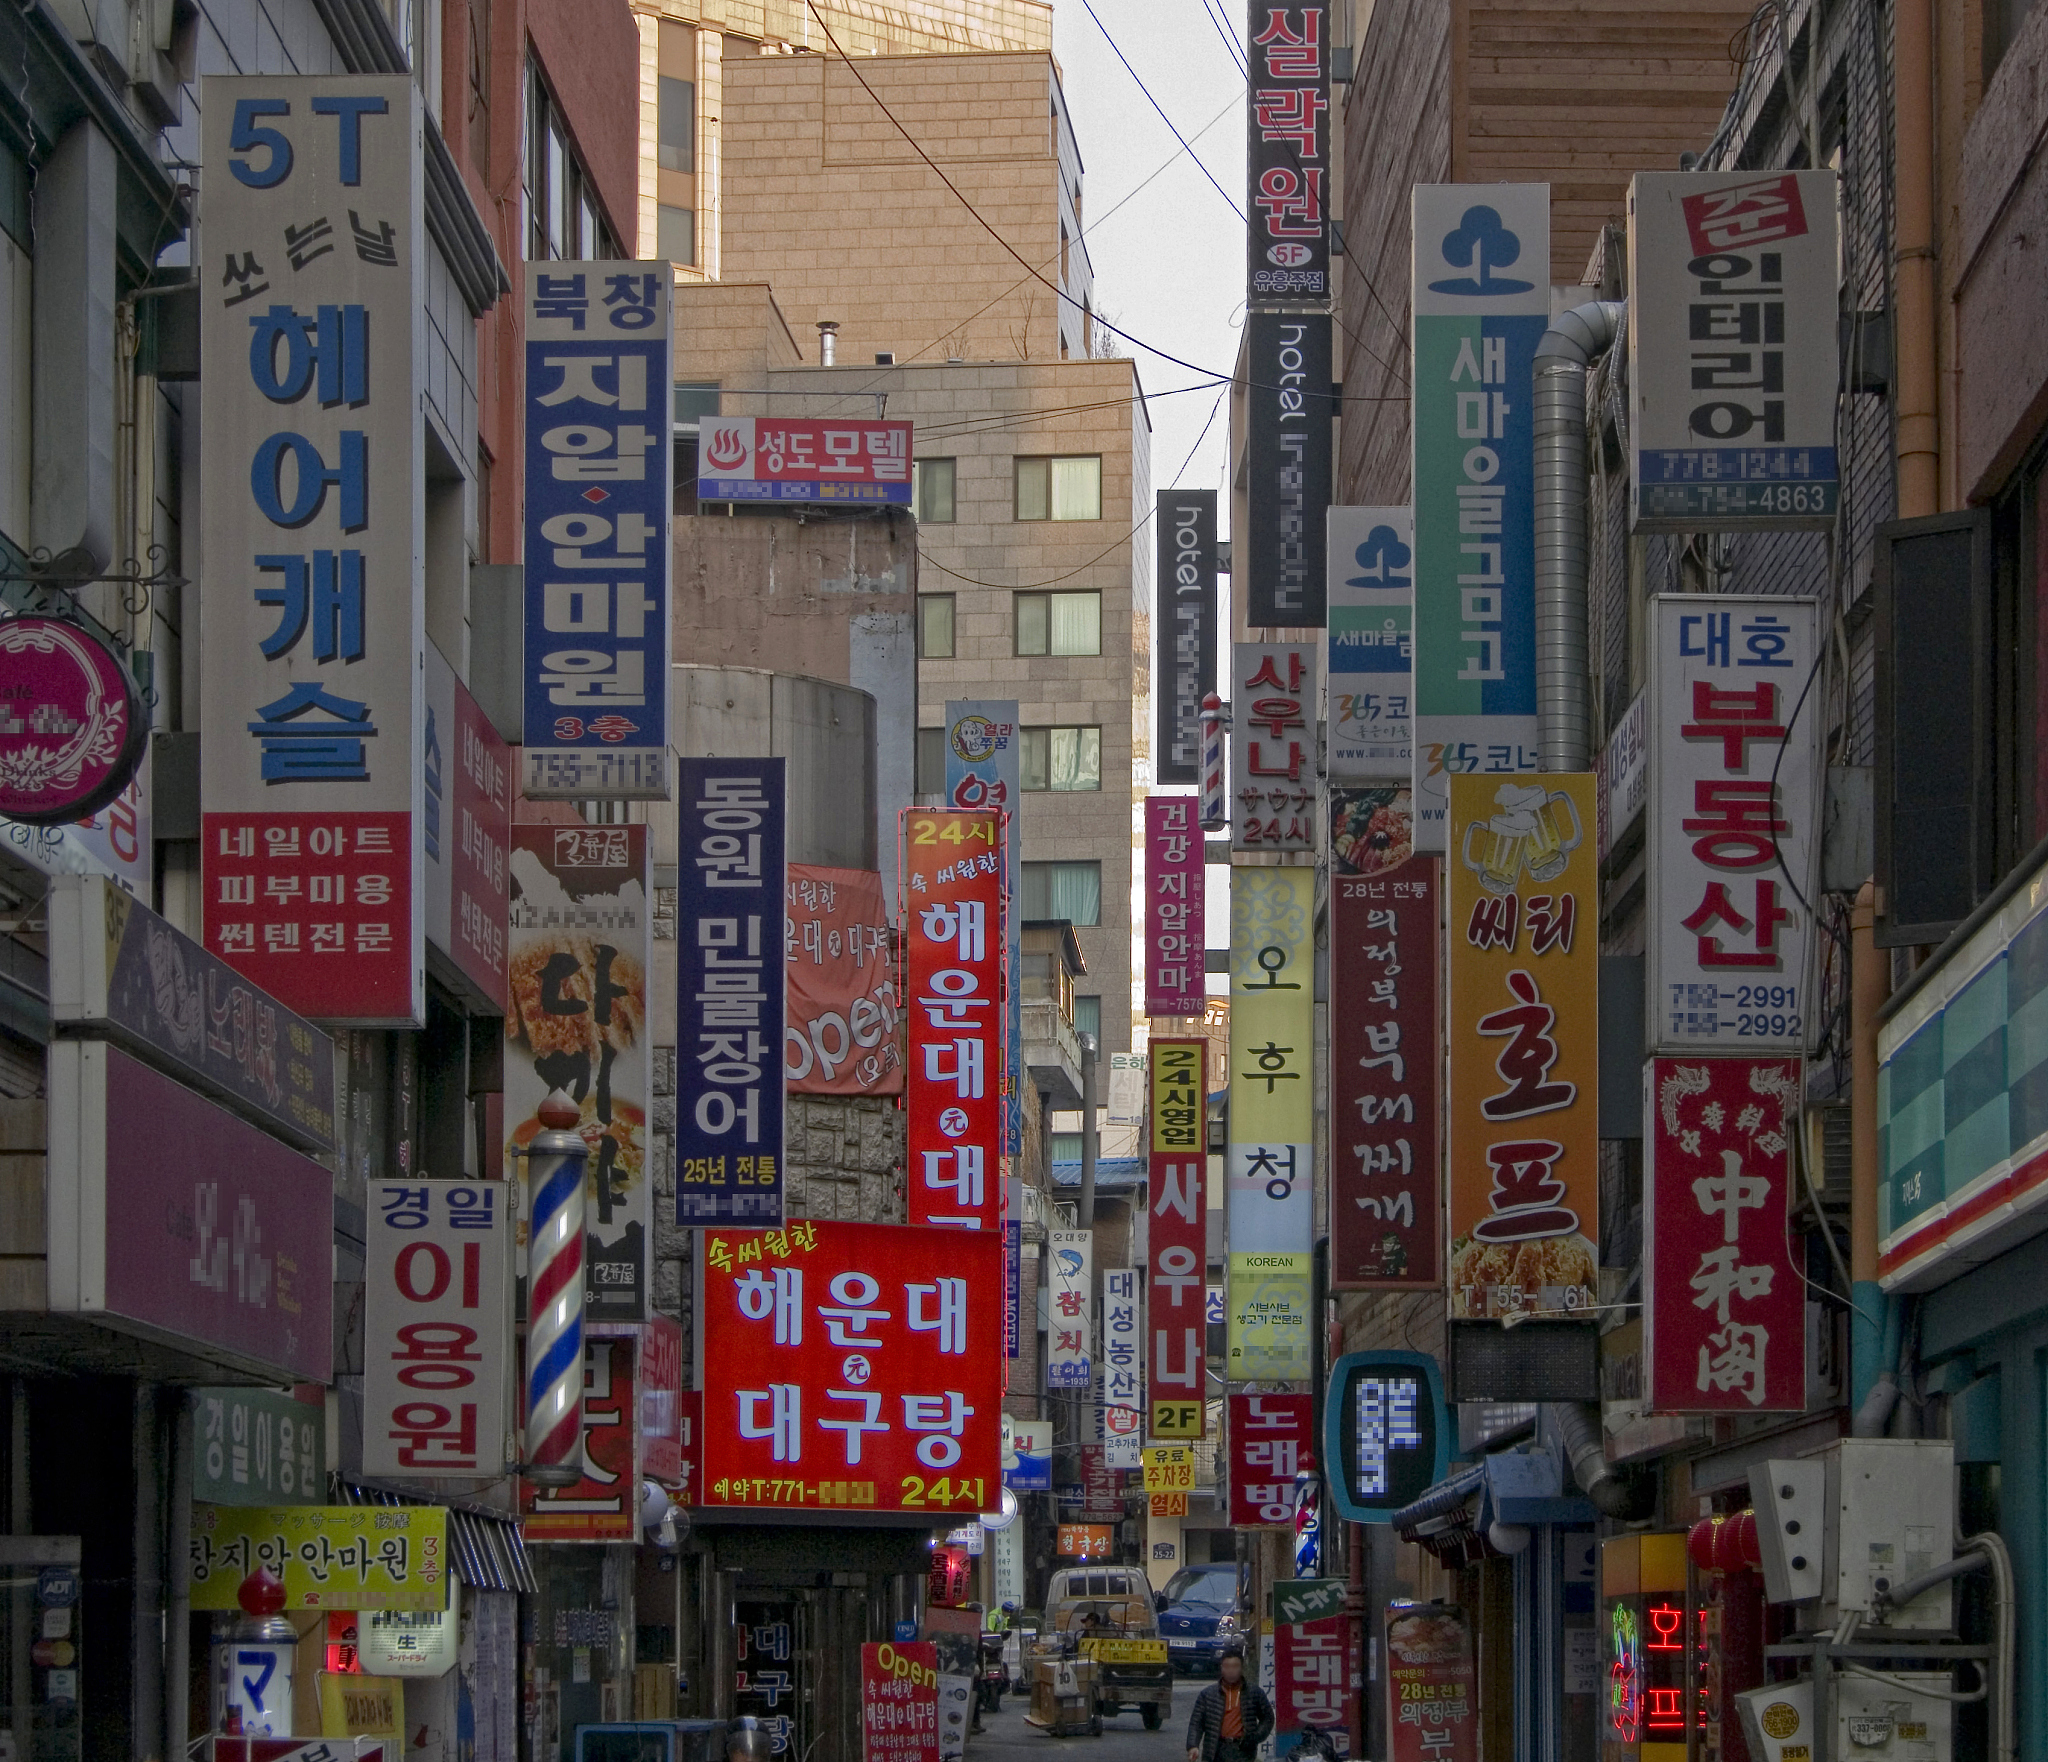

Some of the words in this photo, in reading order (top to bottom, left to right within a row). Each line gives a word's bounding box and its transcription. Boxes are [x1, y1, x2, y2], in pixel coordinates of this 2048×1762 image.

[228, 96, 388, 189] 5T
[1253, 8, 1327, 238] 실락원
[1696, 177, 1793, 250] 준
[1276, 246, 1304, 264] 5F
[532, 273, 661, 330] 북창
[1254, 271, 1323, 292] 유흥주점
[1687, 252, 1785, 442] 인테리어
[1279, 324, 1307, 422] hotel
[1450, 337, 1510, 679] 새마을금고
[247, 304, 377, 787] 헤어캐슬
[1176, 507, 1203, 595] hotel
[1679, 612, 1793, 668] 대호
[554, 715, 640, 742] 3층
[1245, 652, 1306, 780] 사우나
[1420, 742, 1479, 776] 365
[1237, 787, 1316, 812] サウナ
[218, 826, 393, 858] 네일아트
[695, 777, 769, 887] 동원
[913, 819, 994, 846] 24시
[1157, 803, 1191, 863] 건강
[1243, 817, 1311, 843] 24시
[1680, 681, 1791, 973] 부동산
[218, 873, 393, 905] 피부미용
[1343, 883, 1385, 898] 28년
[1393, 882, 1427, 898] 전통
[218, 921, 393, 954] 썬텐전문
[1363, 909, 1402, 1009] 의정부
[918, 901, 991, 1098] 해운대
[695, 915, 769, 1143] 민물장어
[1242, 946, 1301, 1200] 오후청
[1159, 1051, 1196, 1145] 24시영업
[1473, 969, 1578, 1242] 호프
[684, 1156, 726, 1185] 25년
[737, 1156, 777, 1185] 전통
[381, 1187, 493, 1230] 경일
[1053, 1233, 1088, 1242] 오대양
[1154, 1163, 1202, 1388] 사우나
[1246, 1257, 1293, 1267] KOREAN
[733, 1267, 967, 1354] 해운대
[1055, 1291, 1086, 1355] 참치
[1236, 1315, 1268, 1325] 생고기
[1271, 1315, 1303, 1325] 전문점
[388, 1242, 482, 1468] 이용원
[1108, 1272, 1135, 1398] 대성농산
[735, 1383, 974, 1468] 대구탕
[1111, 1408, 1134, 1430] 쌀
[1157, 1407, 1196, 1428] 2F
[205, 1398, 315, 1498] 경일이용원
[1107, 1439, 1138, 1449] 고추가루
[1154, 1450, 1184, 1462] 유료
[901, 1476, 984, 1507] 24시
[1148, 1465, 1191, 1487] 주차장
[1151, 1494, 1187, 1517] 열쇠
[418, 1537, 440, 1583] 3층
[1154, 1551, 1174, 1559] 25-22
[44, 1580, 72, 1595] ADT
[398, 1635, 416, 1649] 生
[877, 1643, 937, 1690] Open
[1291, 1624, 1351, 1723] 노래방
[1648, 1603, 1684, 1728] 호프
[1399, 1700, 1469, 1726] 의정부
[1400, 1683, 1435, 1700] 28년
[1440, 1683, 1467, 1697] 전통
[1764, 1717, 1798, 1728] 766-1900
